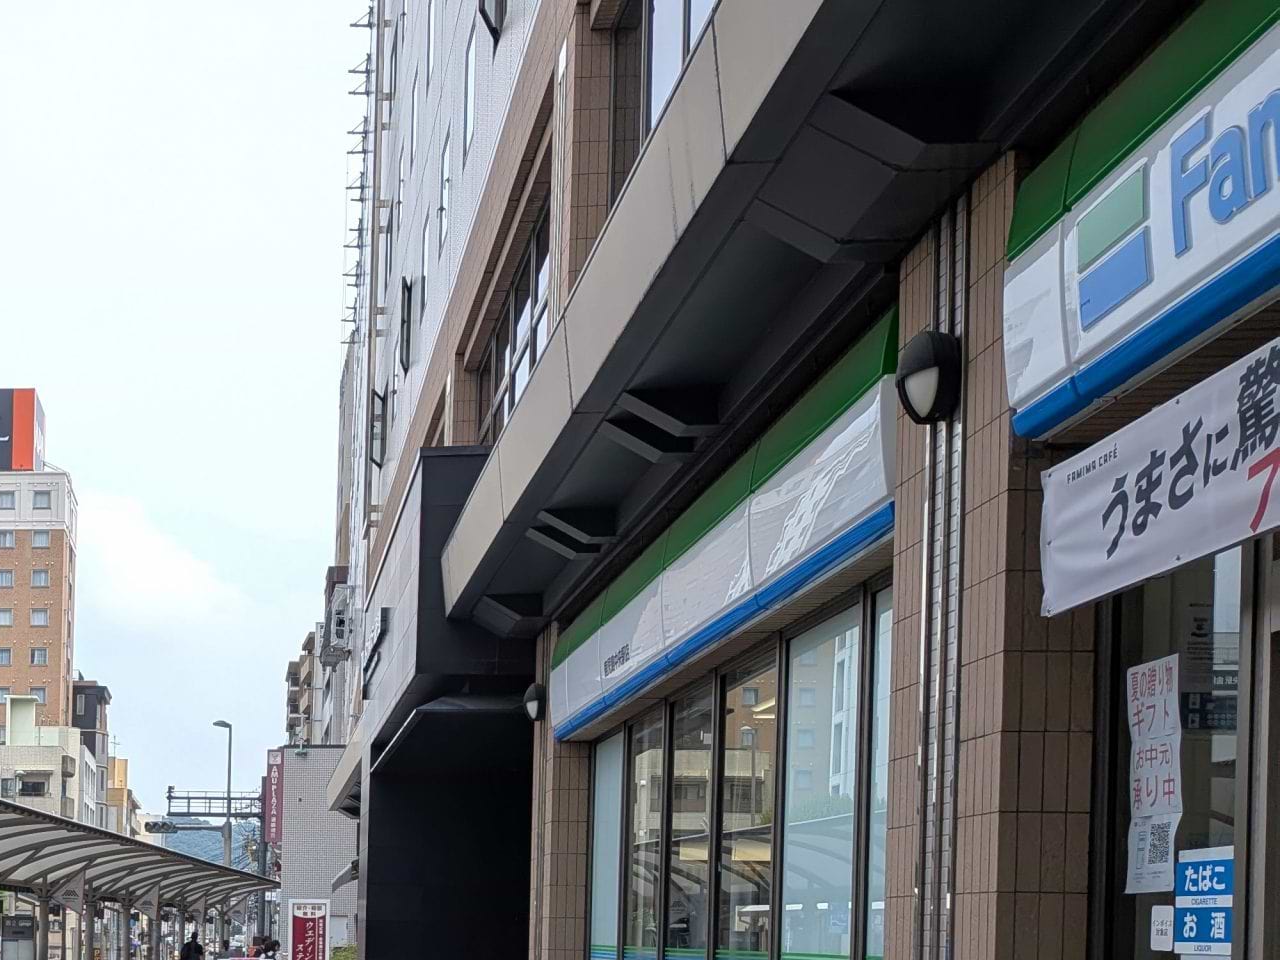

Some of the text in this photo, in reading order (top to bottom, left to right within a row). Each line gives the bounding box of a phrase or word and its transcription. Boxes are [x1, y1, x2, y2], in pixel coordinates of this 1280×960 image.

[1066, 442, 1118, 484] FAMIMA CAFÉ
[1130, 660, 1174, 703] 夏の贈り物
[1131, 698, 1170, 737] ギフト
[1132, 773, 1176, 811] 承り中
[1184, 864, 1226, 892] たばこ
[1190, 897, 1219, 906] CIGARETTE
[1183, 911, 1226, 940] お酒
[1193, 944, 1212, 952] LIQUOR
